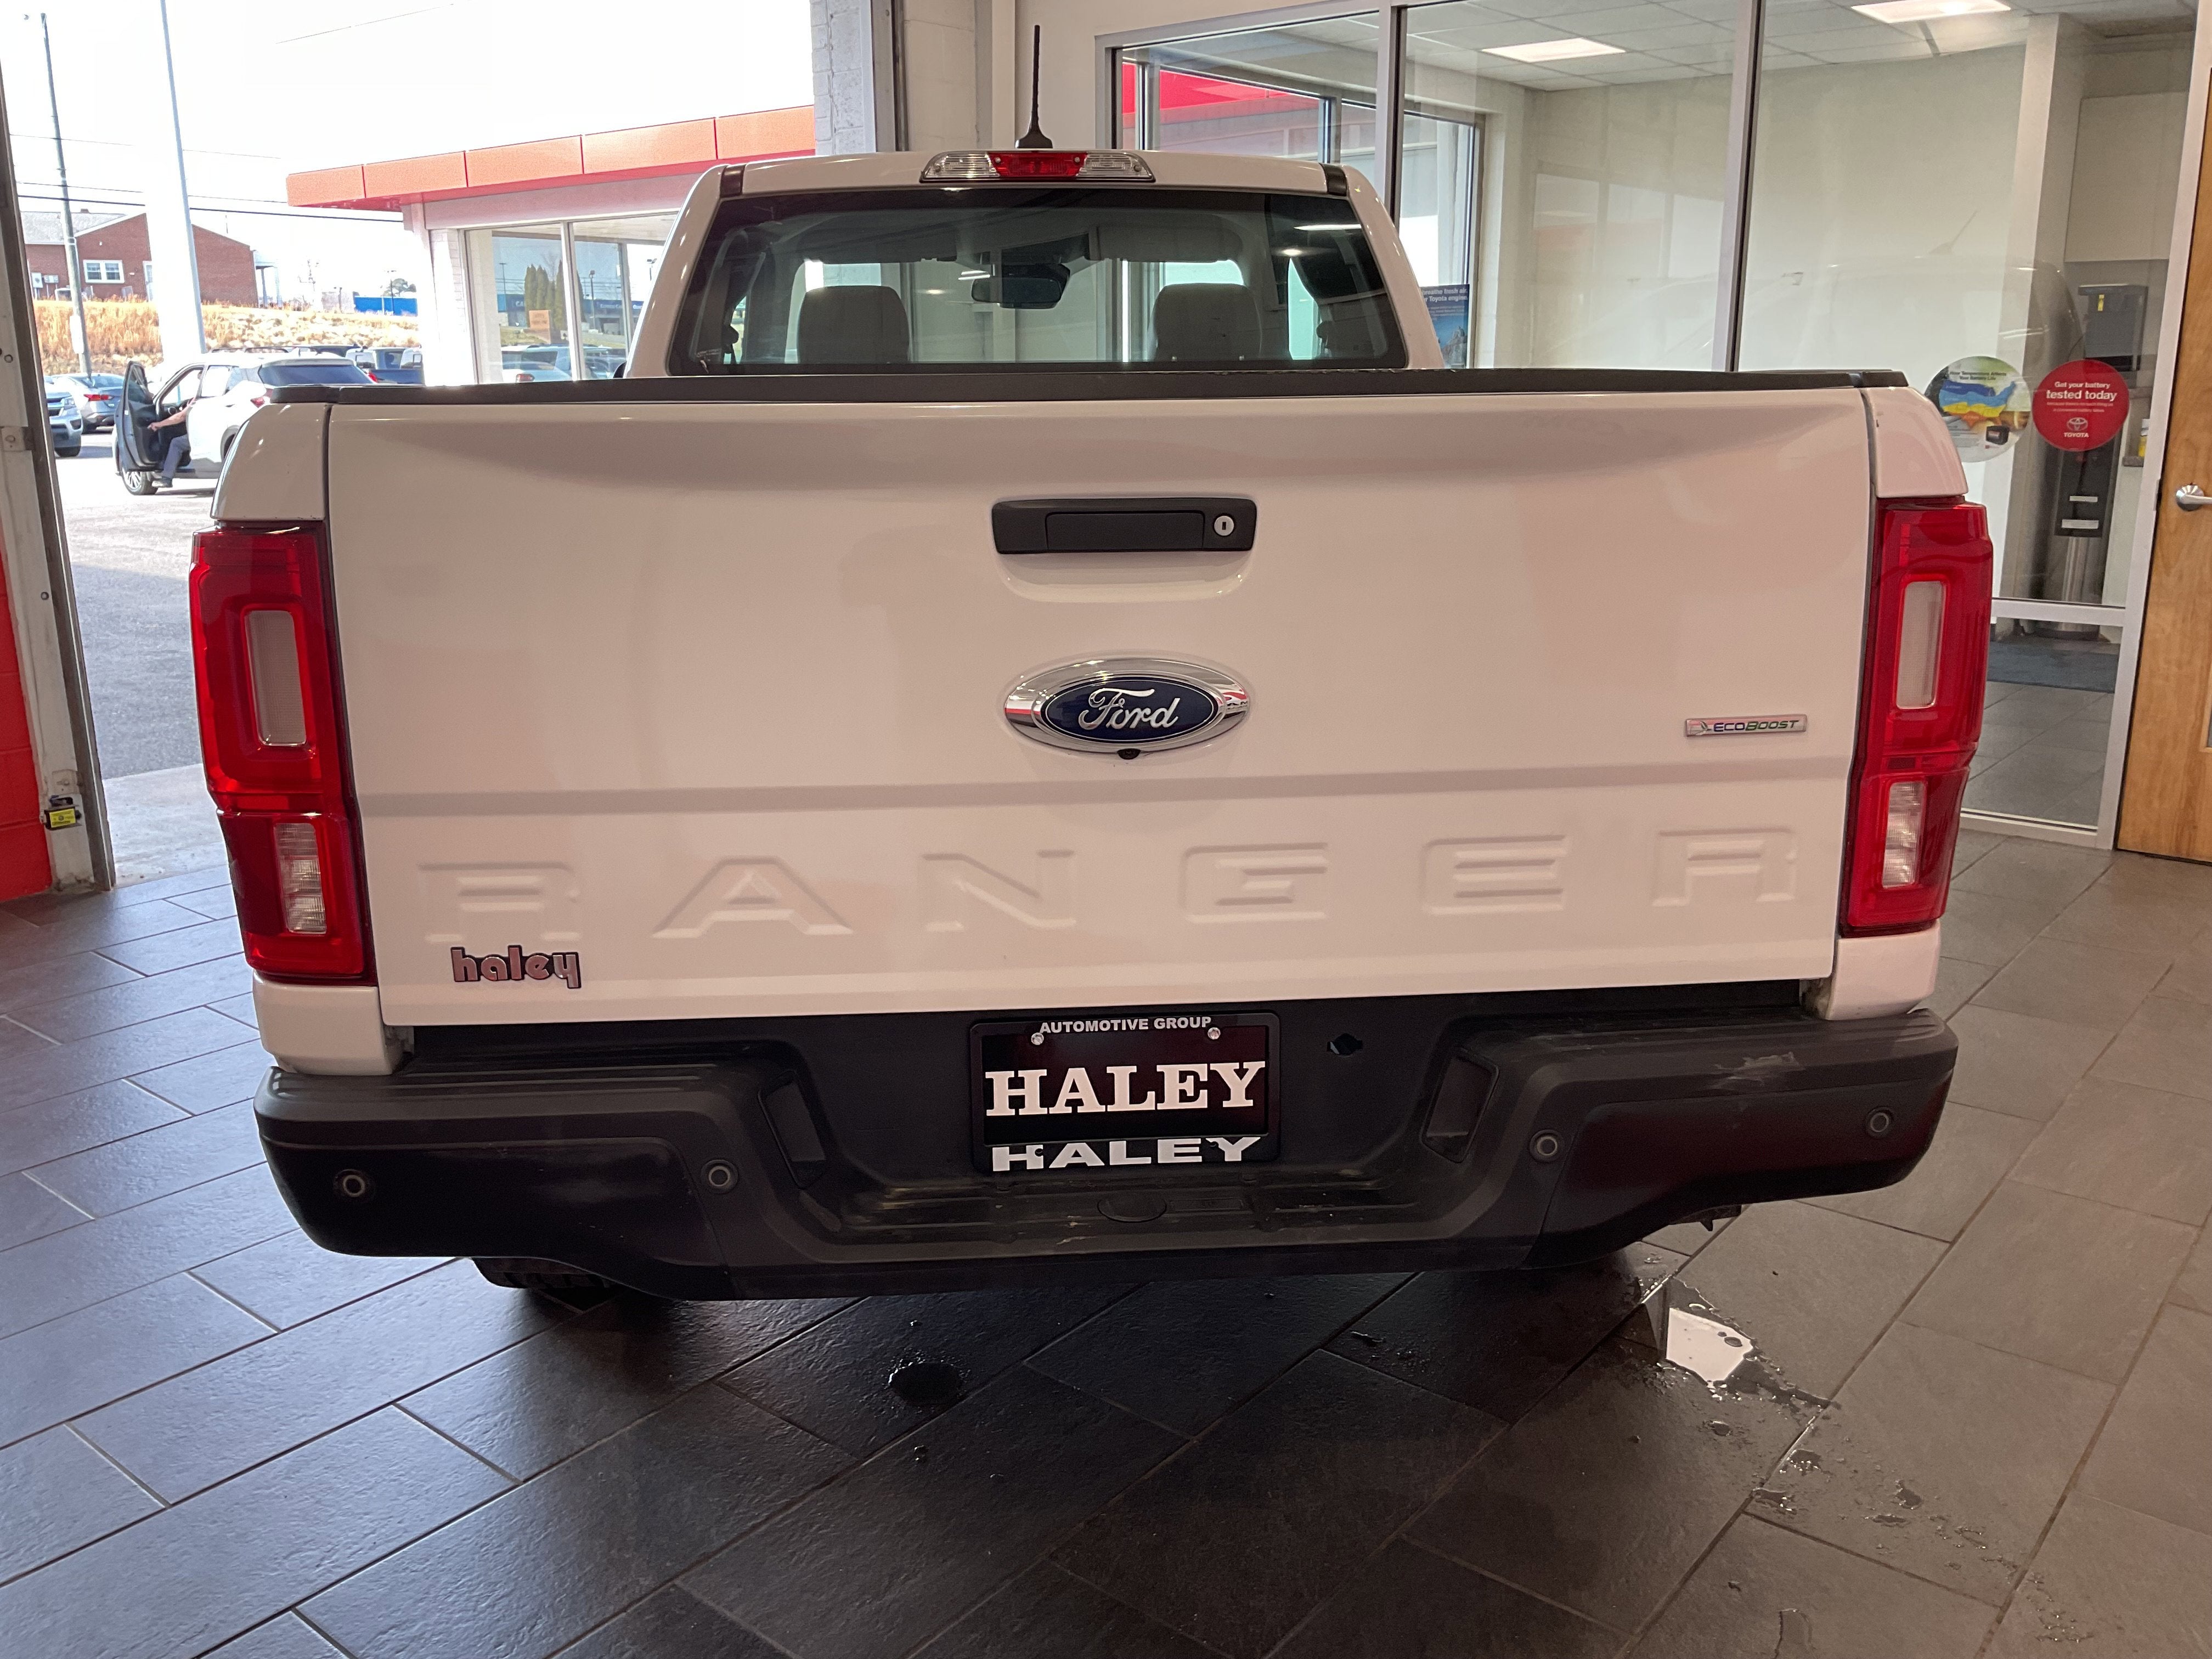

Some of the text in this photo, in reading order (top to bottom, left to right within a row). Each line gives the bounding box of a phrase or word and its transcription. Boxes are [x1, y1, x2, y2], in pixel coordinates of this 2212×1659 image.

[2046, 390, 2117, 401] tested today
[1078, 688, 1181, 730] Ford
[1713, 720, 1799, 732] ECOBOOST
[417, 826, 1797, 944] RANGER
[451, 945, 582, 989] haley
[1040, 1016, 1211, 1034] AUTOMOTIVE GROUP
[985, 1061, 1265, 1116] HALEY
[992, 1137, 1261, 1171] HALEY
